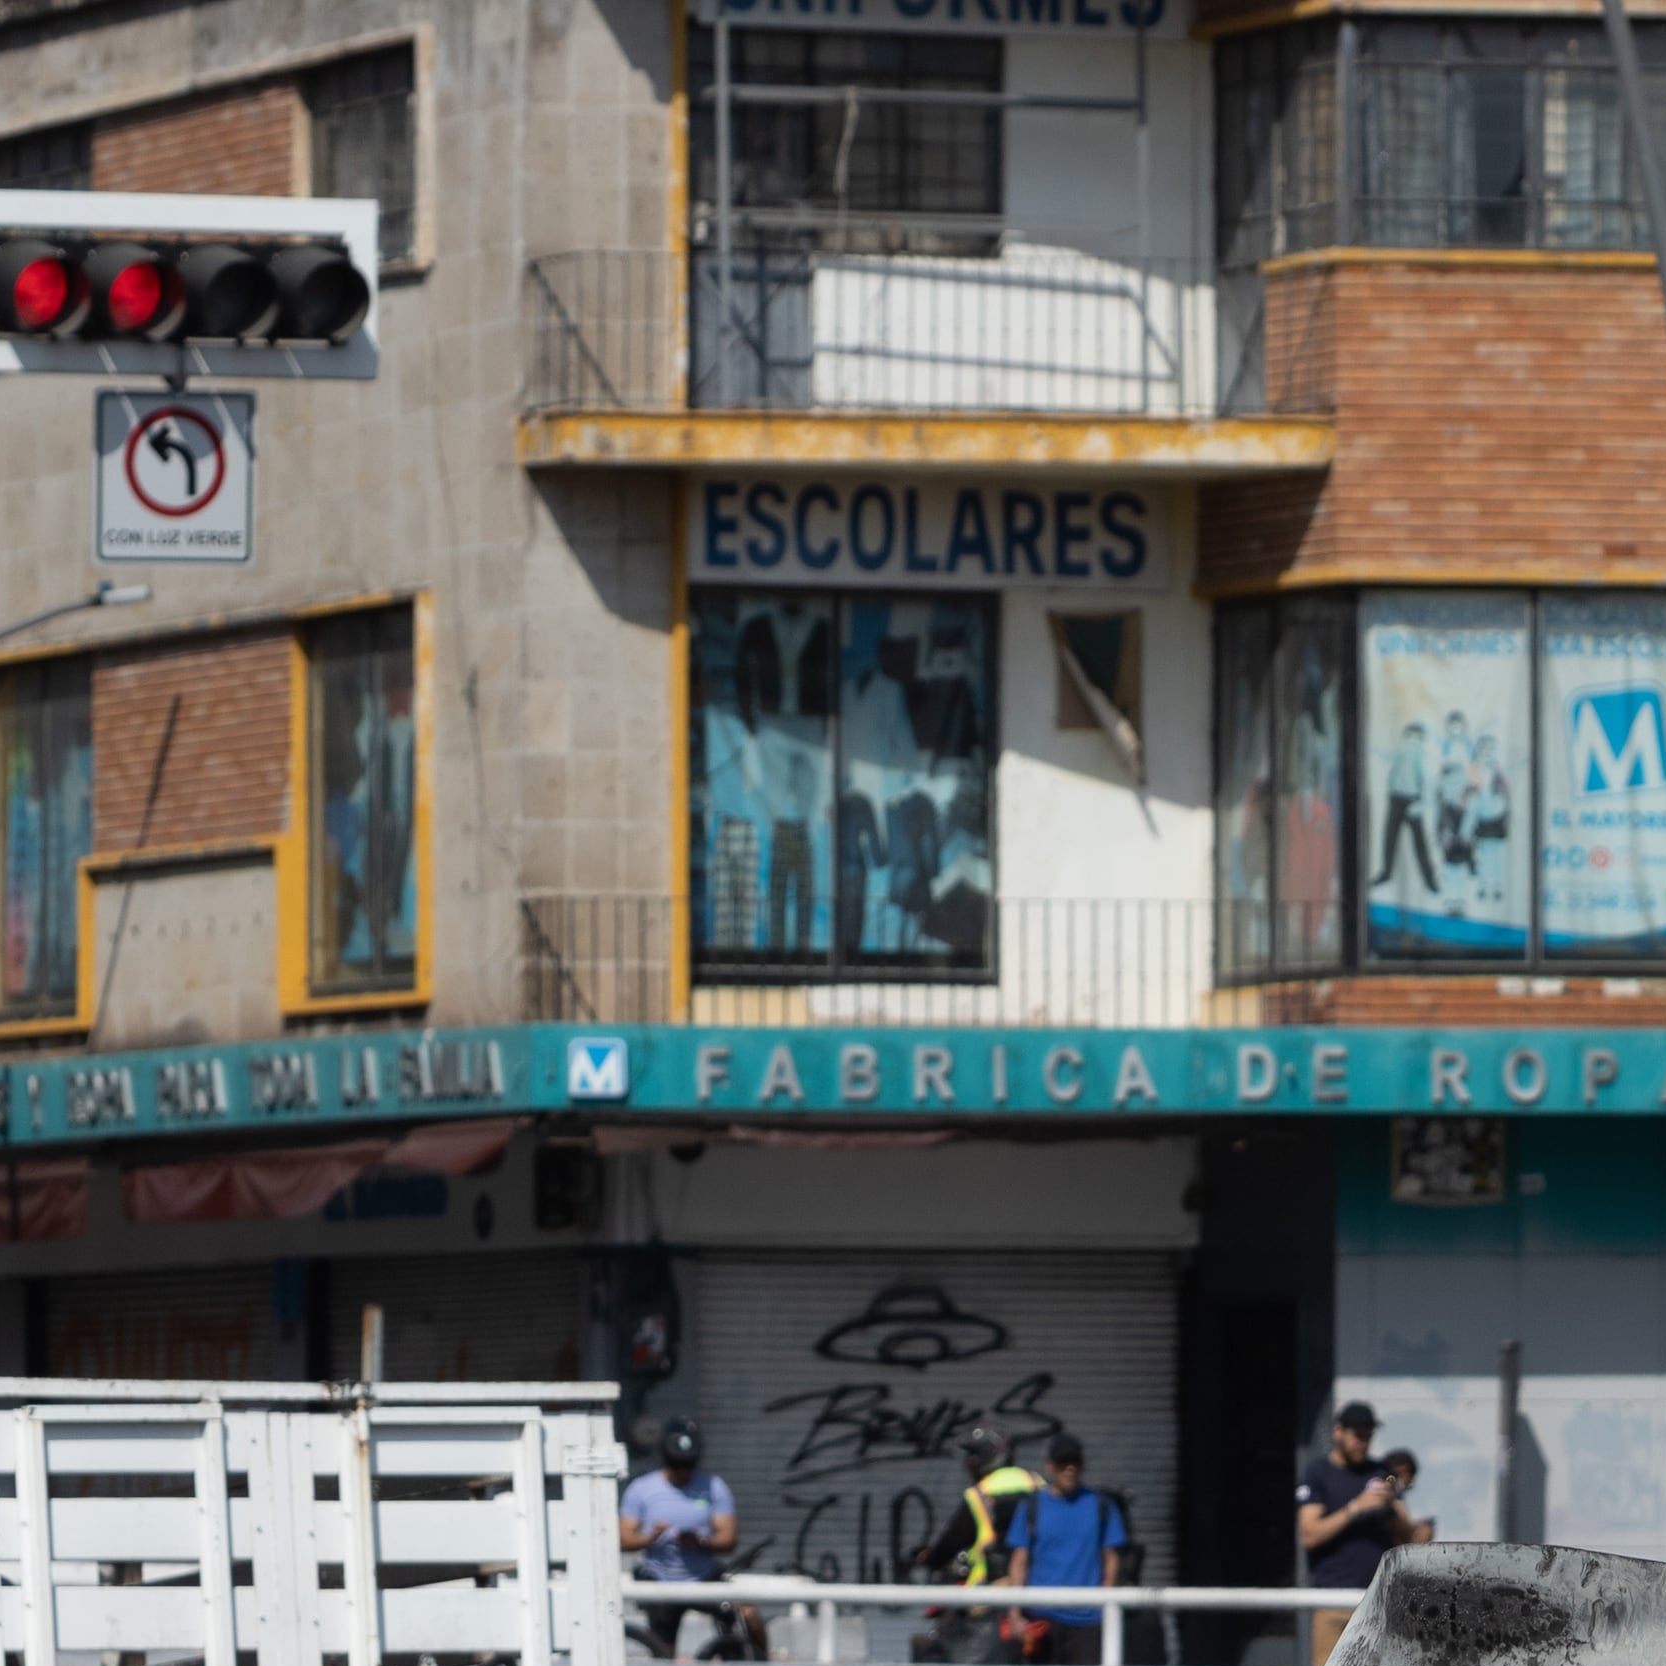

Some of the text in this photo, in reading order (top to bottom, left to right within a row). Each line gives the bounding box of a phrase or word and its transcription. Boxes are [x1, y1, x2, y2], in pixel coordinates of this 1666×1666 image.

[105, 528, 143, 545] CON
[187, 528, 244, 546] VERDE
[703, 481, 1149, 579] ESCOLARES
[695, 1043, 1159, 1103] FABRICA
[1237, 1044, 1350, 1102] DE
